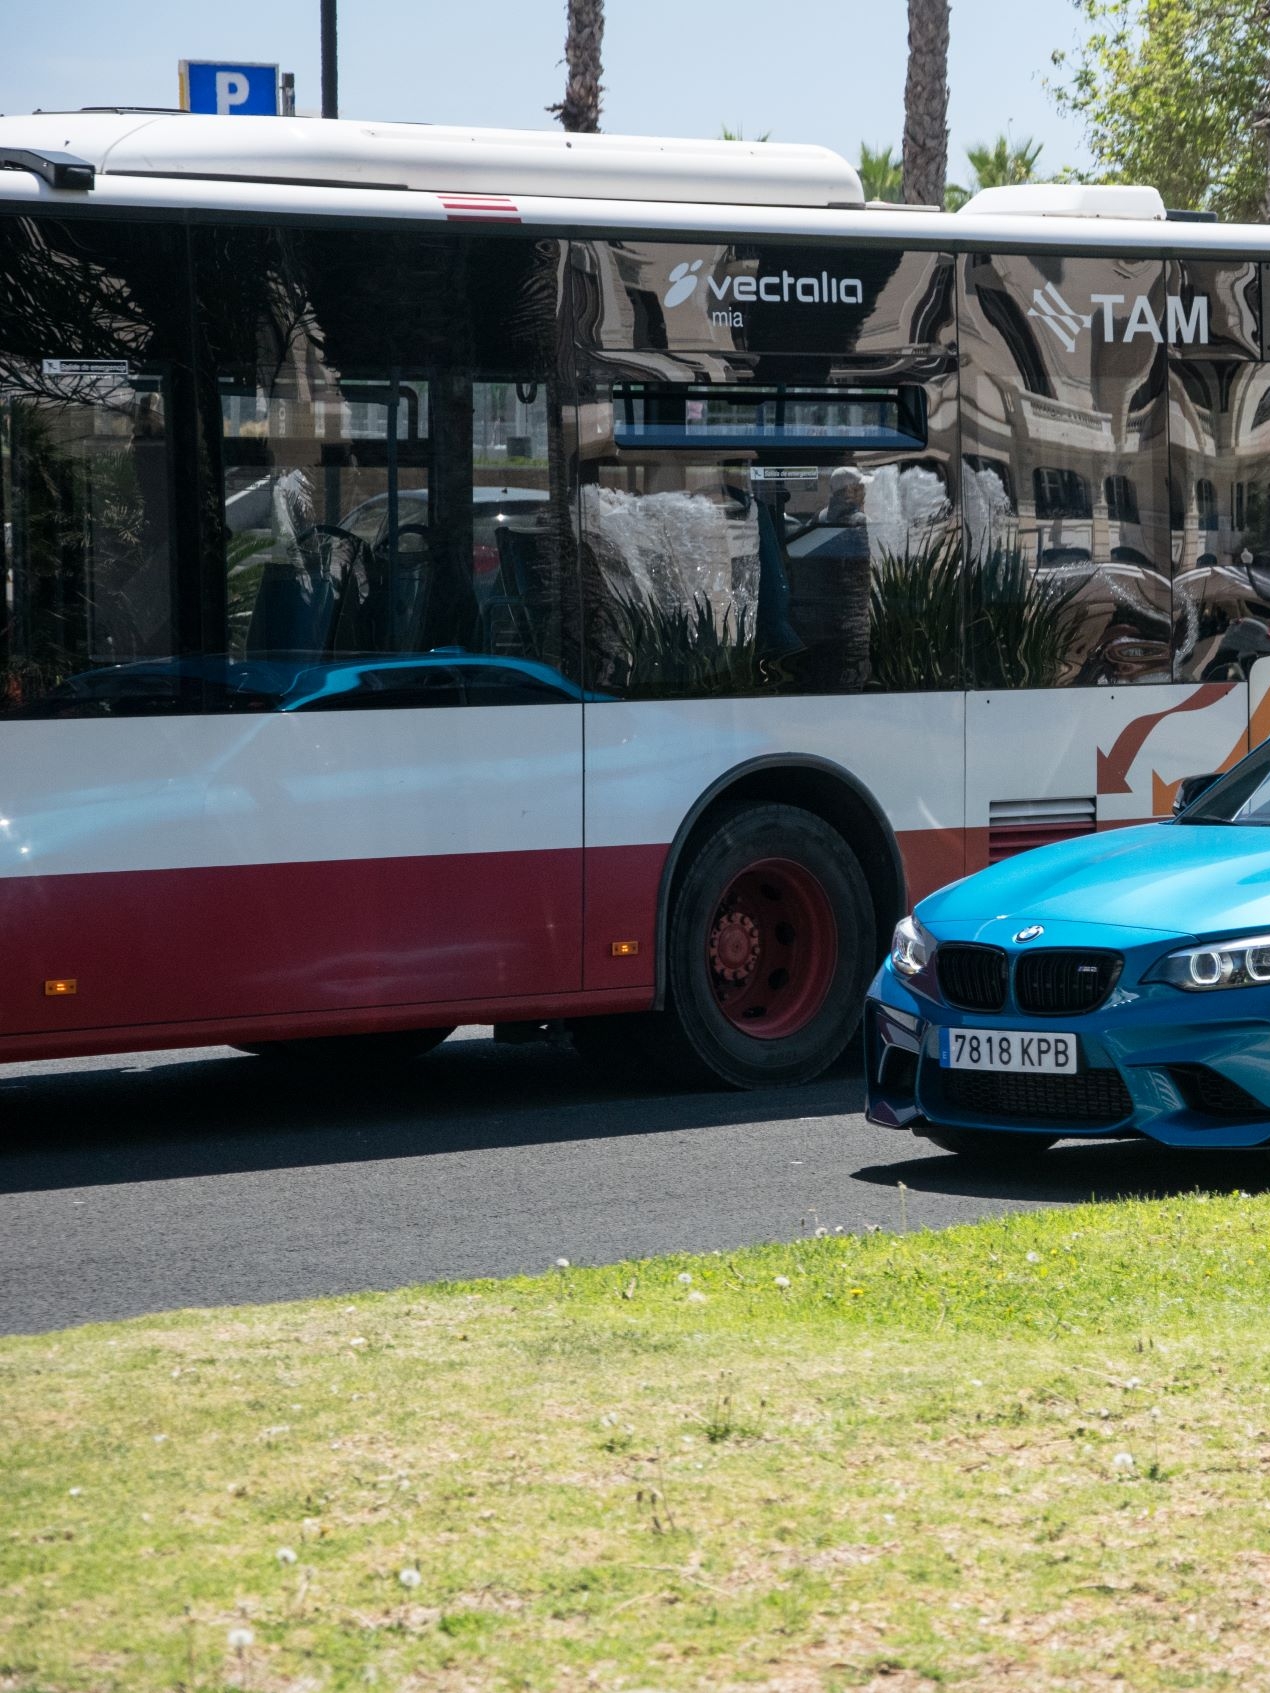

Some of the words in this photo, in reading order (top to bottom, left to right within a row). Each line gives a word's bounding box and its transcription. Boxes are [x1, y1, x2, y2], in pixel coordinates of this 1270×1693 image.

[216, 71, 250, 115] P
[706, 269, 863, 304] vectalia
[711, 306, 744, 328] mia
[1090, 293, 1209, 344] TAM
[954, 1034, 1012, 1066] 7818
[1020, 1037, 1070, 1068] KPB
